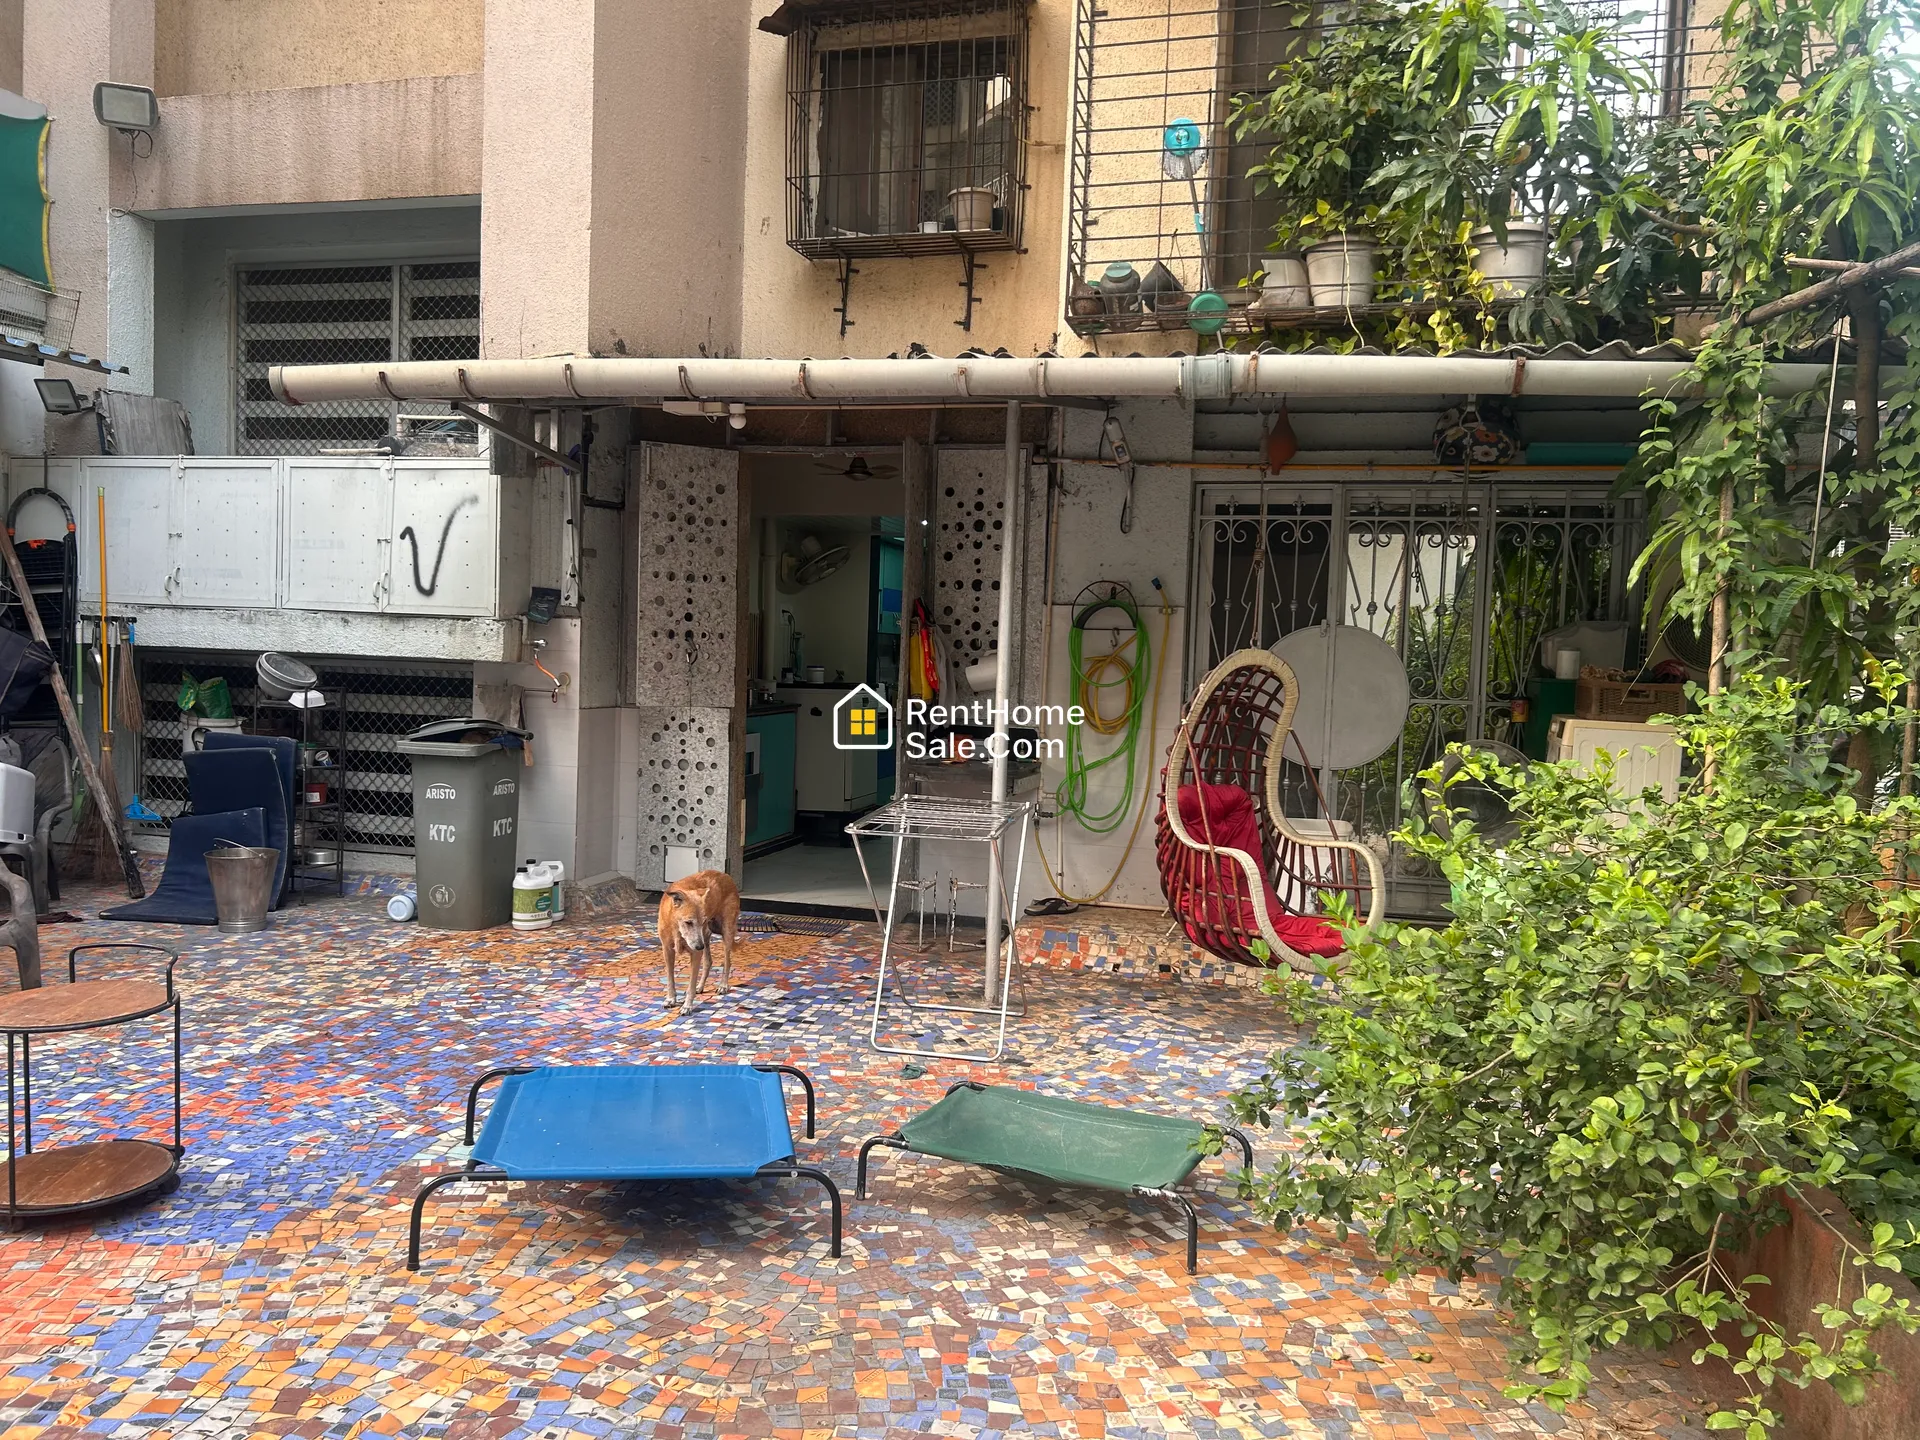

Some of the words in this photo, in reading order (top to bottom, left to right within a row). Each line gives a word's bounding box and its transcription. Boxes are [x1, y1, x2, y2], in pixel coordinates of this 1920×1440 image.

[425, 788, 456, 800] ARISTO
[493, 782, 515, 796] ARISTO
[429, 823, 456, 843] KTC
[493, 817, 513, 837] KTC
